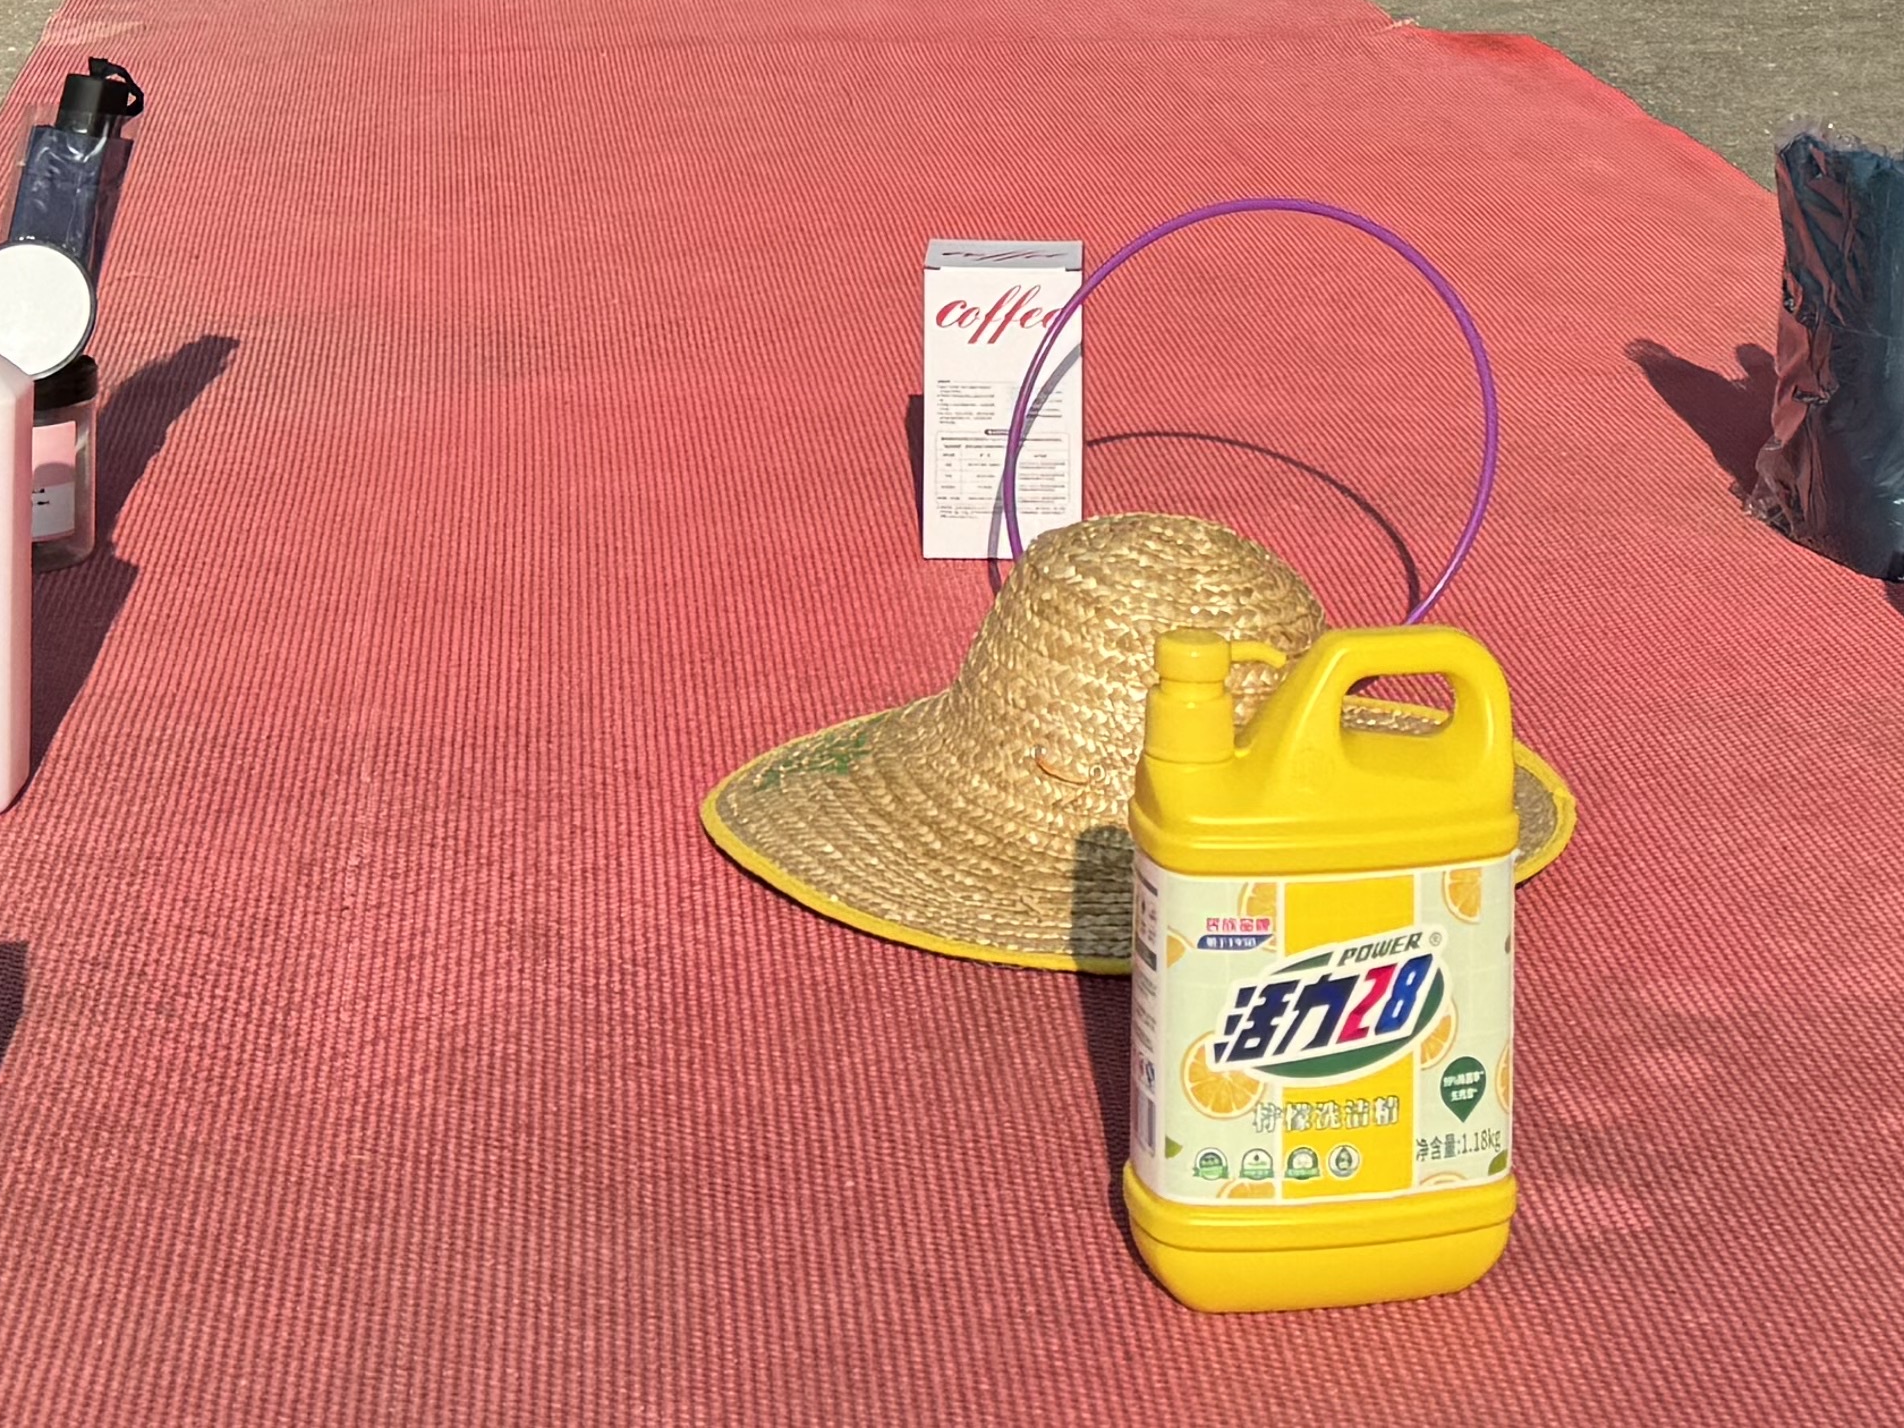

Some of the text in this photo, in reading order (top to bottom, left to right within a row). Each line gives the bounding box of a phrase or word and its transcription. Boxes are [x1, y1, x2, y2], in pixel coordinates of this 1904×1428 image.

[1206, 917, 1272, 933] 民族品牌
[1337, 931, 1423, 967] POWER
[1213, 952, 1434, 1064] 活力28
[1252, 1095, 1400, 1133] 柠檬洗洁精
